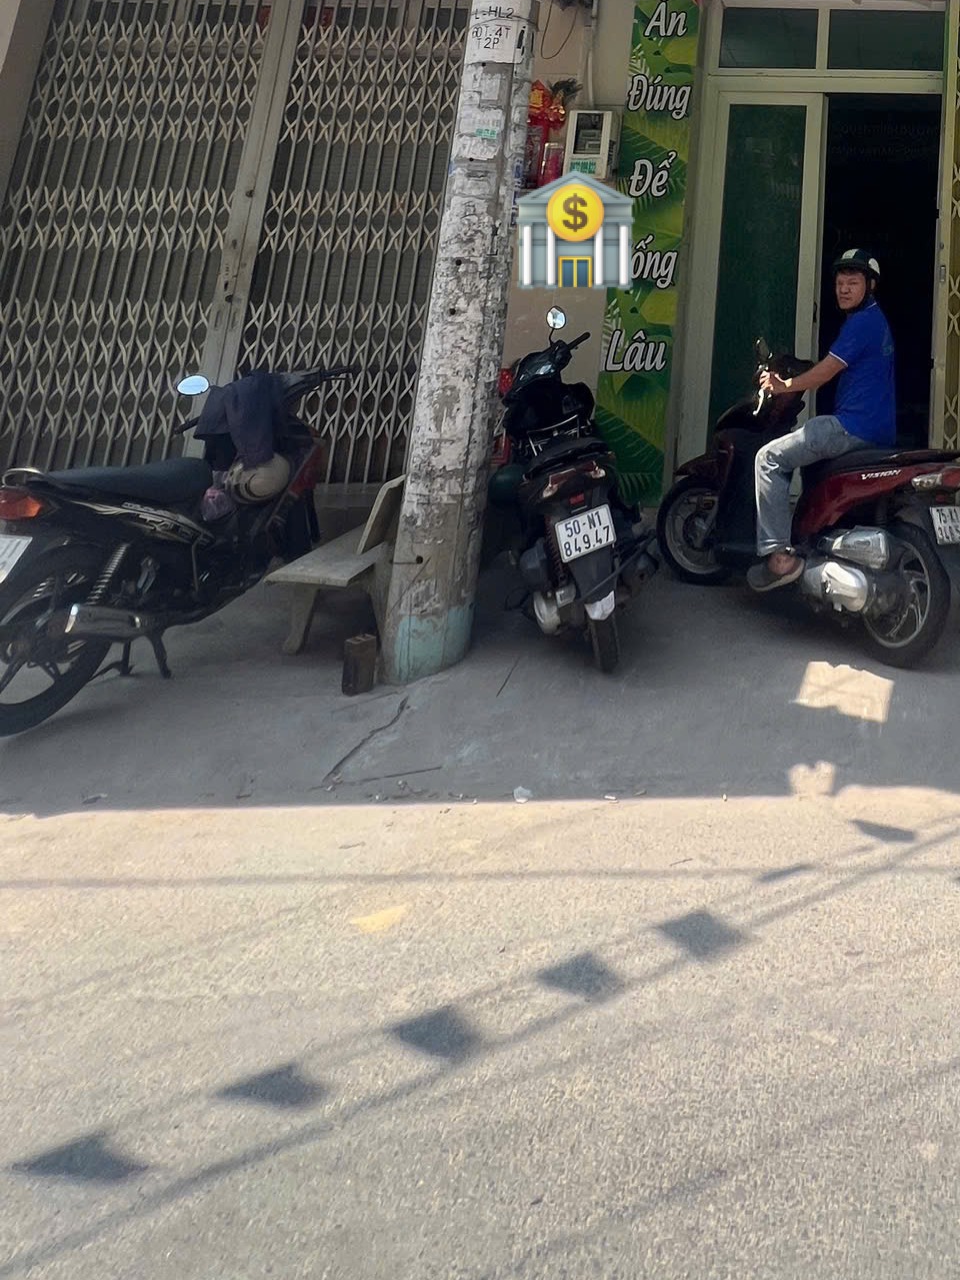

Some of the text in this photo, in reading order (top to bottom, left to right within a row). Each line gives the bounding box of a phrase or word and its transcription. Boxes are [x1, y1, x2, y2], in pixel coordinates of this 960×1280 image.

[627, 74, 691, 120] Đúng
[629, 150, 677, 198] Để
[631, 235, 678, 289] ống
[603, 329, 668, 373] Lâu
[861, 469, 902, 480] VISION
[563, 525, 610, 557] 849.47
[564, 511, 602, 538] 50-N1
